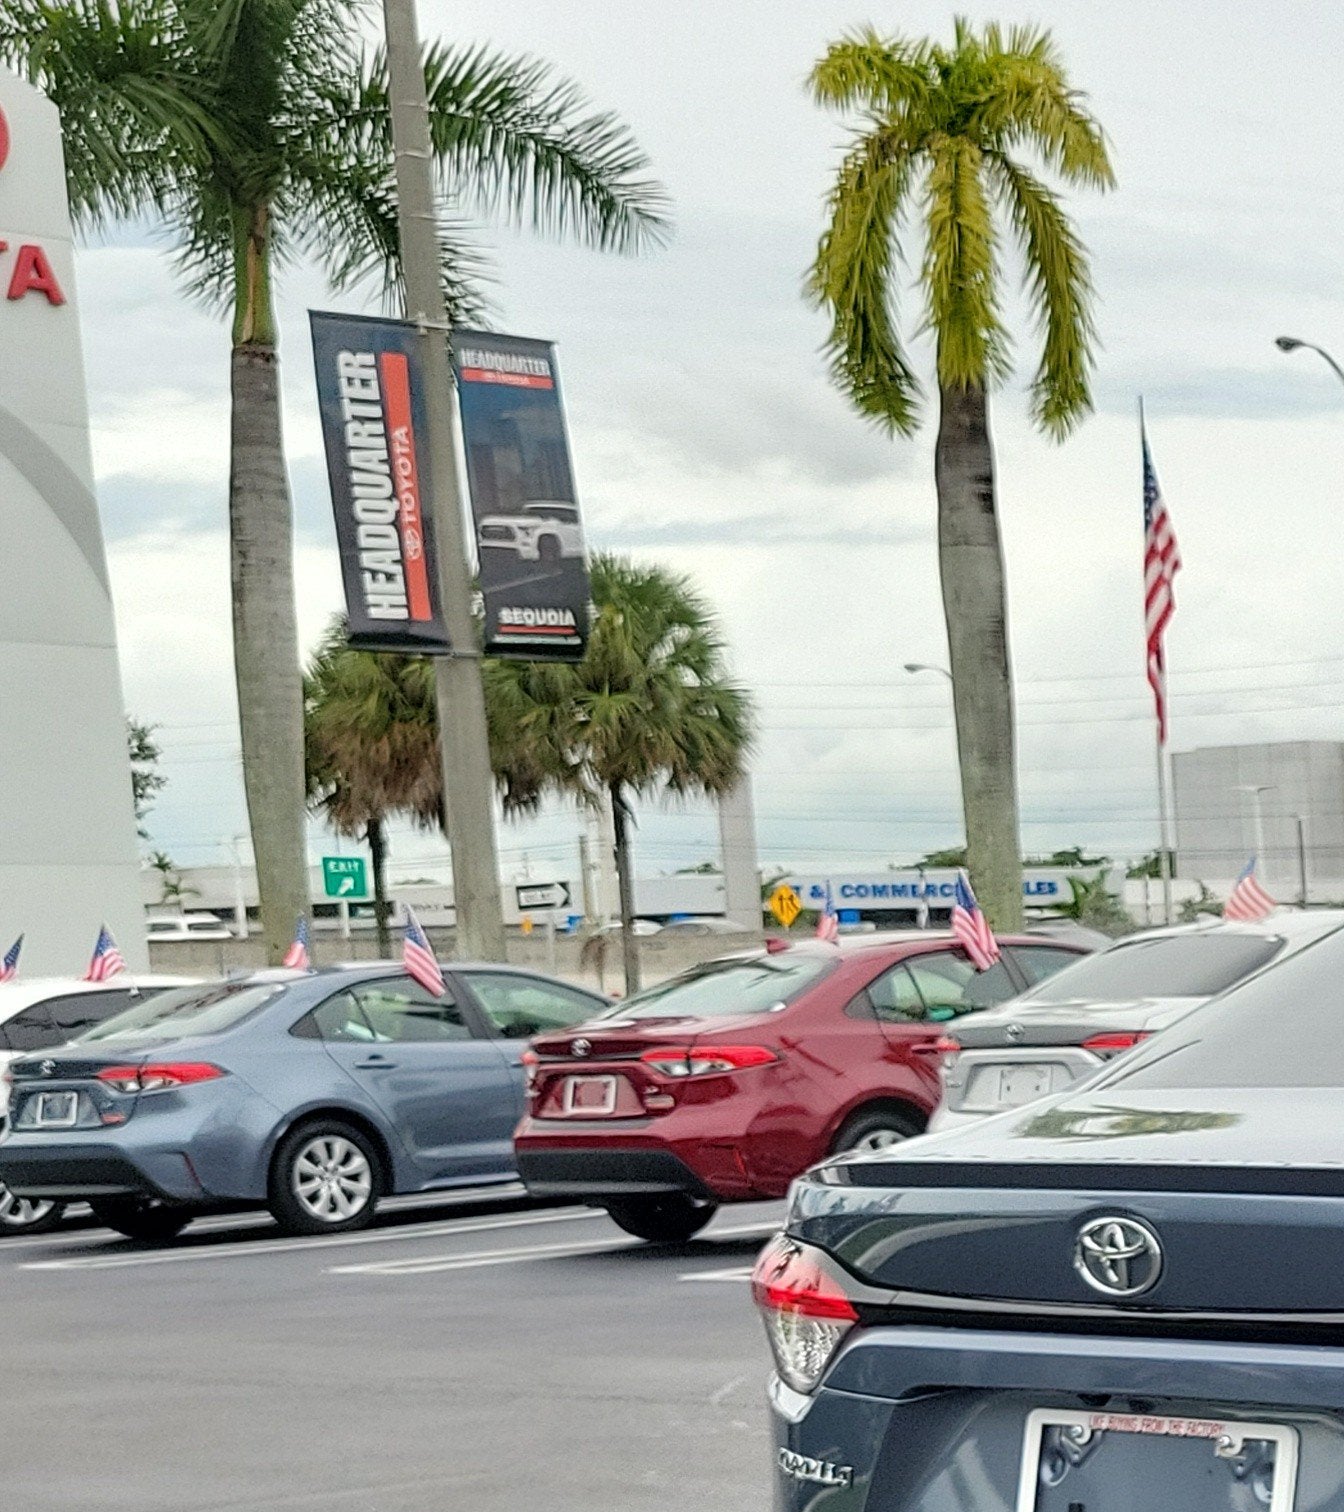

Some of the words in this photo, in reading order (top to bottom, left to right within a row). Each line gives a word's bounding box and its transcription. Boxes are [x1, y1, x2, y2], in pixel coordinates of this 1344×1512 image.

[460, 348, 551, 377] HEADQUARTER
[338, 351, 409, 620] HEADQUARTER
[391, 427, 417, 526] TOYOTA
[499, 606, 576, 627] SEQUOIA
[328, 860, 359, 872] EXIT
[841, 883, 960, 899] COMMERC
